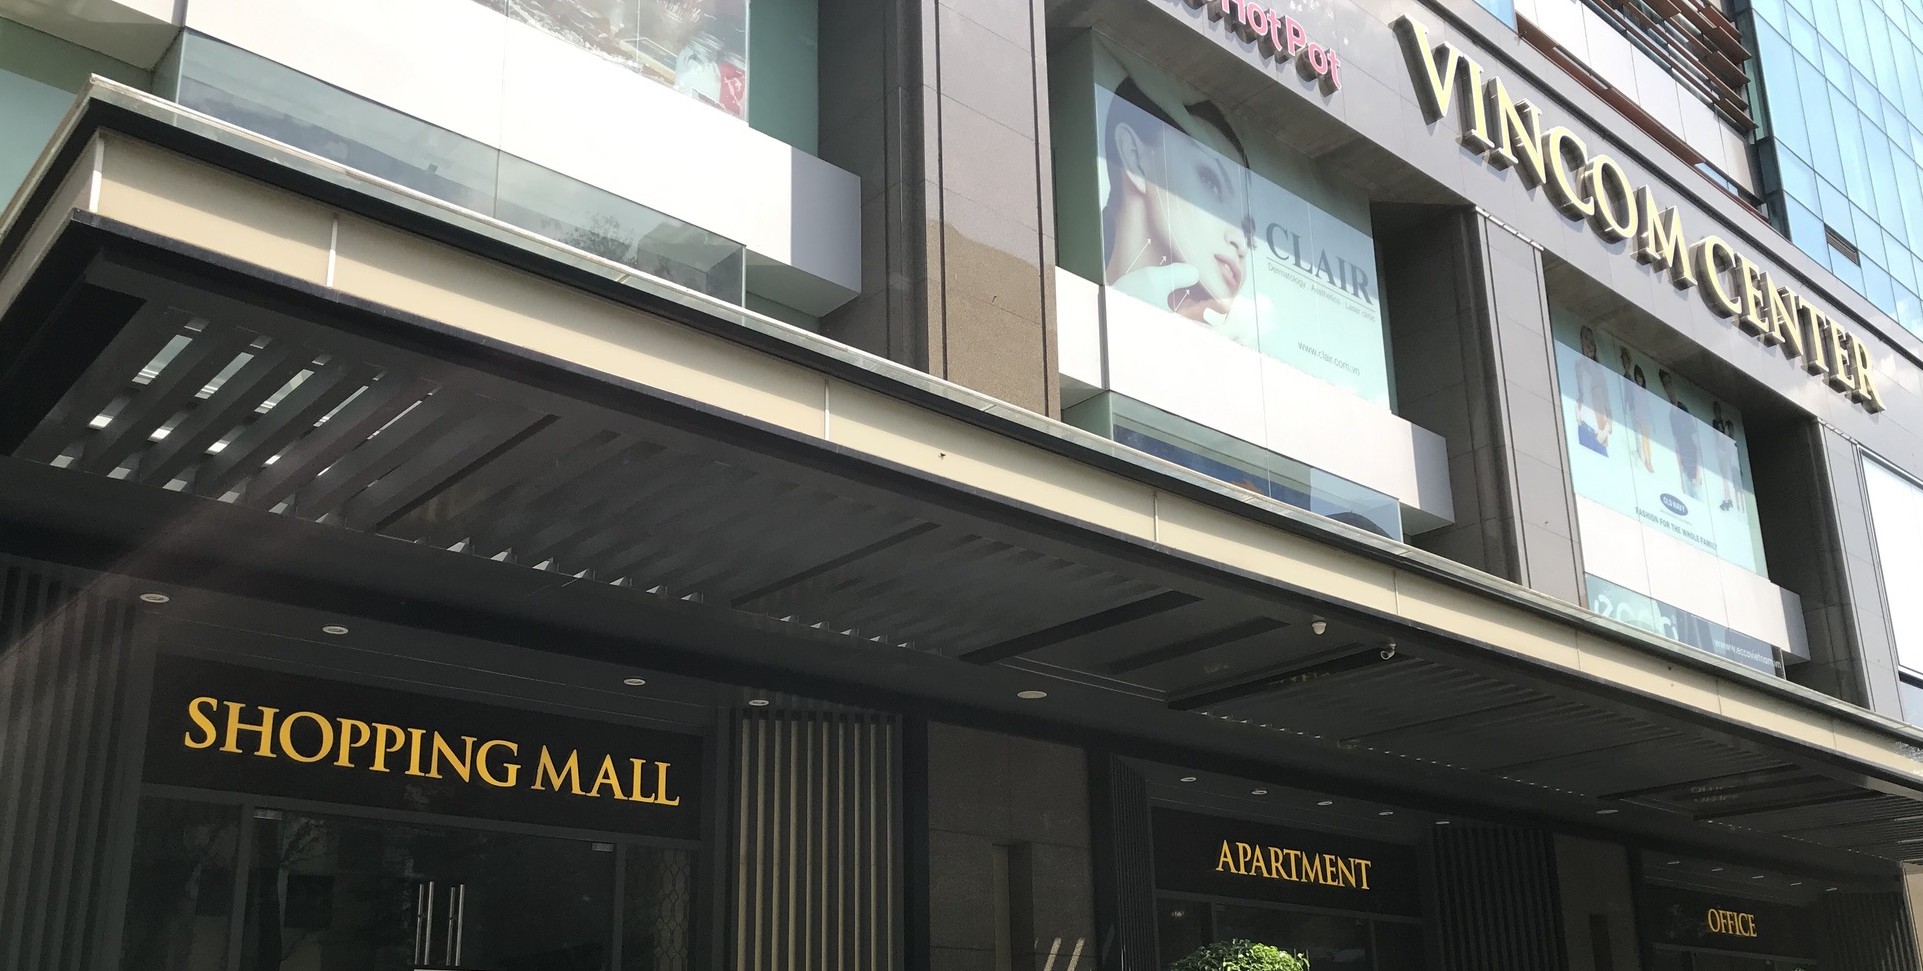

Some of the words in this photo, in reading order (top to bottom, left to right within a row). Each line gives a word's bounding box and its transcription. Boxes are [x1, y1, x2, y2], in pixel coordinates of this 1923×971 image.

[1396, 13, 1698, 289] VINCOM
[1700, 235, 1888, 412] CENTER
[1266, 222, 1374, 306] CLAIR
[1267, 262, 1307, 289] Dermatology
[1635, 506, 1659, 524] FASHION
[1659, 518, 1671, 530] FOR
[1671, 523, 1682, 535] THE
[1681, 528, 1700, 543] WHOLE
[1662, 496, 1673, 507] OLD
[1672, 500, 1686, 514] NAVY
[184, 696, 522, 788] SHOPPING
[530, 744, 681, 807] MALL
[1215, 839, 1372, 890] APARTMENT
[1707, 907, 1758, 938] OFFICE
